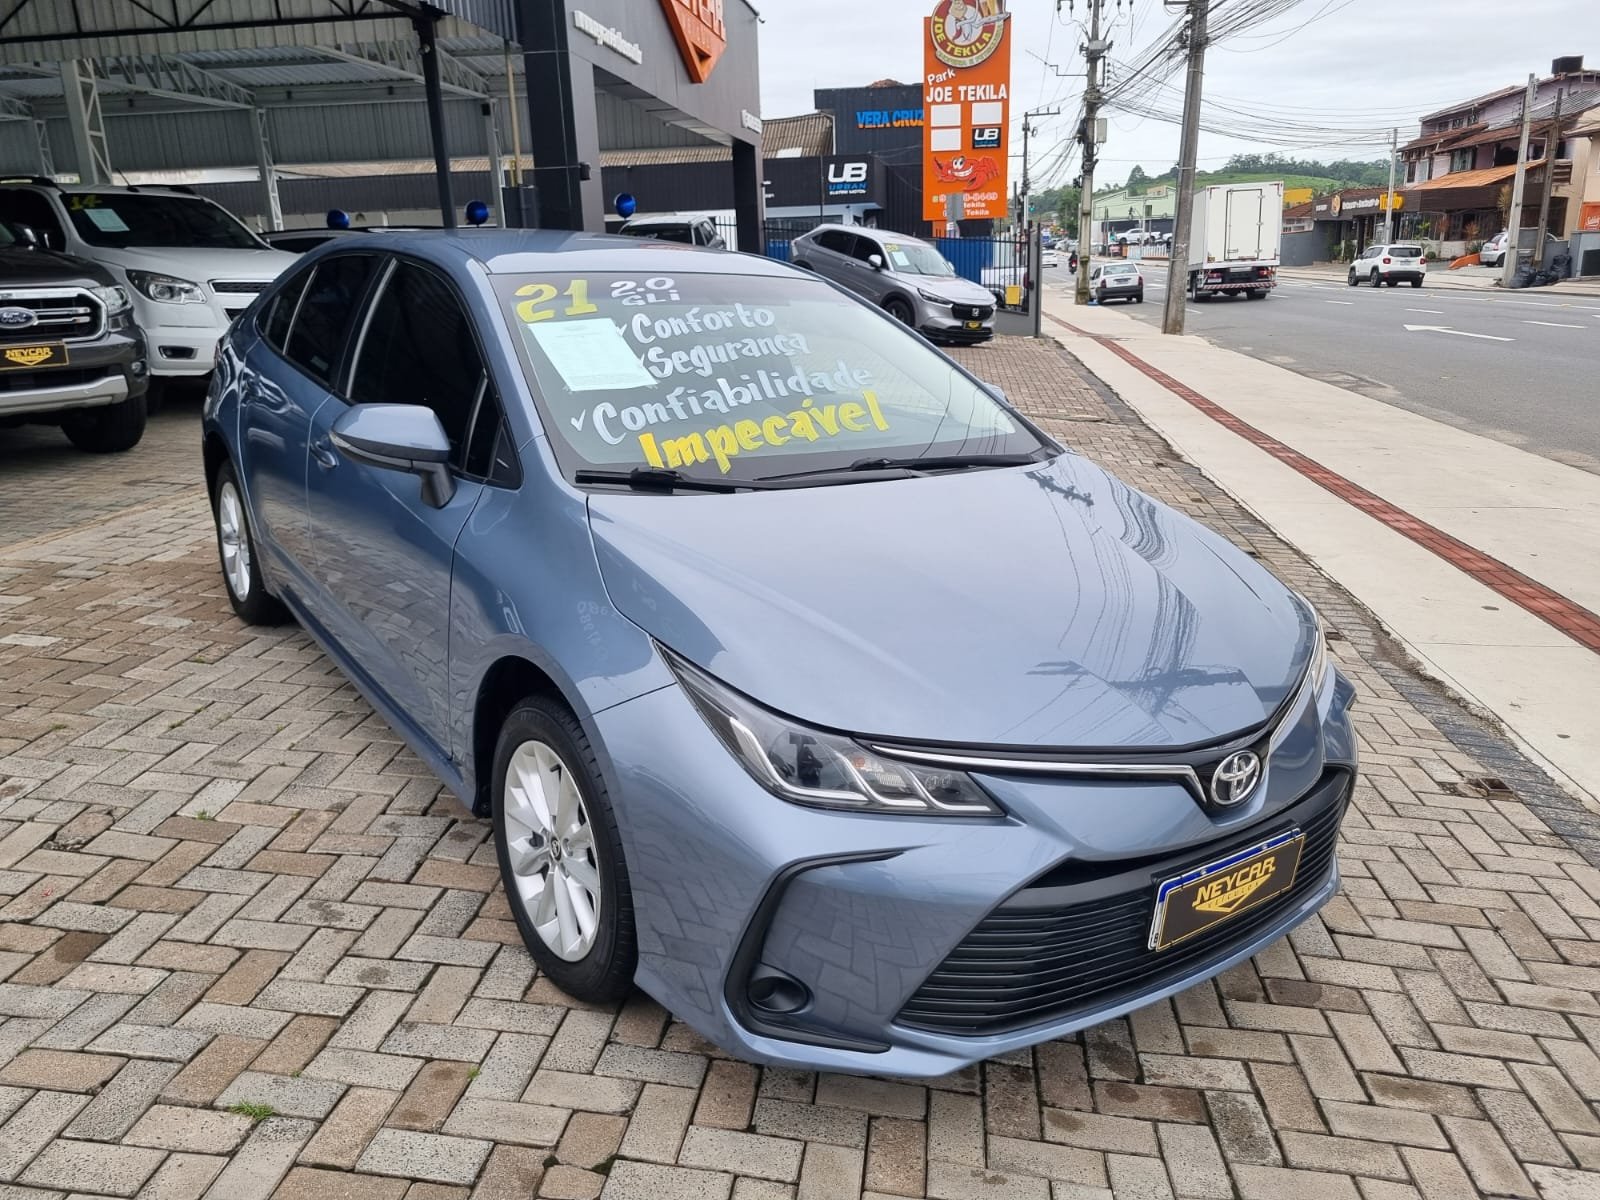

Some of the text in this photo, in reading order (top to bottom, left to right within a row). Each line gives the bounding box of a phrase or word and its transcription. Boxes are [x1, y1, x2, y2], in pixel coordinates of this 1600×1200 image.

[934, 15, 992, 57] JOE TEKILA
[927, 68, 956, 85] Park
[926, 83, 1008, 103] JOE TEKILA
[856, 110, 891, 129] VERA
[974, 128, 999, 141] UB
[828, 162, 868, 183] UB
[829, 183, 867, 191] URBAN
[610, 276, 675, 298] 2.0
[514, 279, 598, 323] 21
[631, 302, 776, 345] Conforto
[5, 346, 53, 358] NEYCAR
[647, 331, 813, 378] Segurança
[592, 359, 874, 445] Confiabilidade
[638, 390, 890, 475] Impecável
[1192, 856, 1276, 908] NEYCAR
